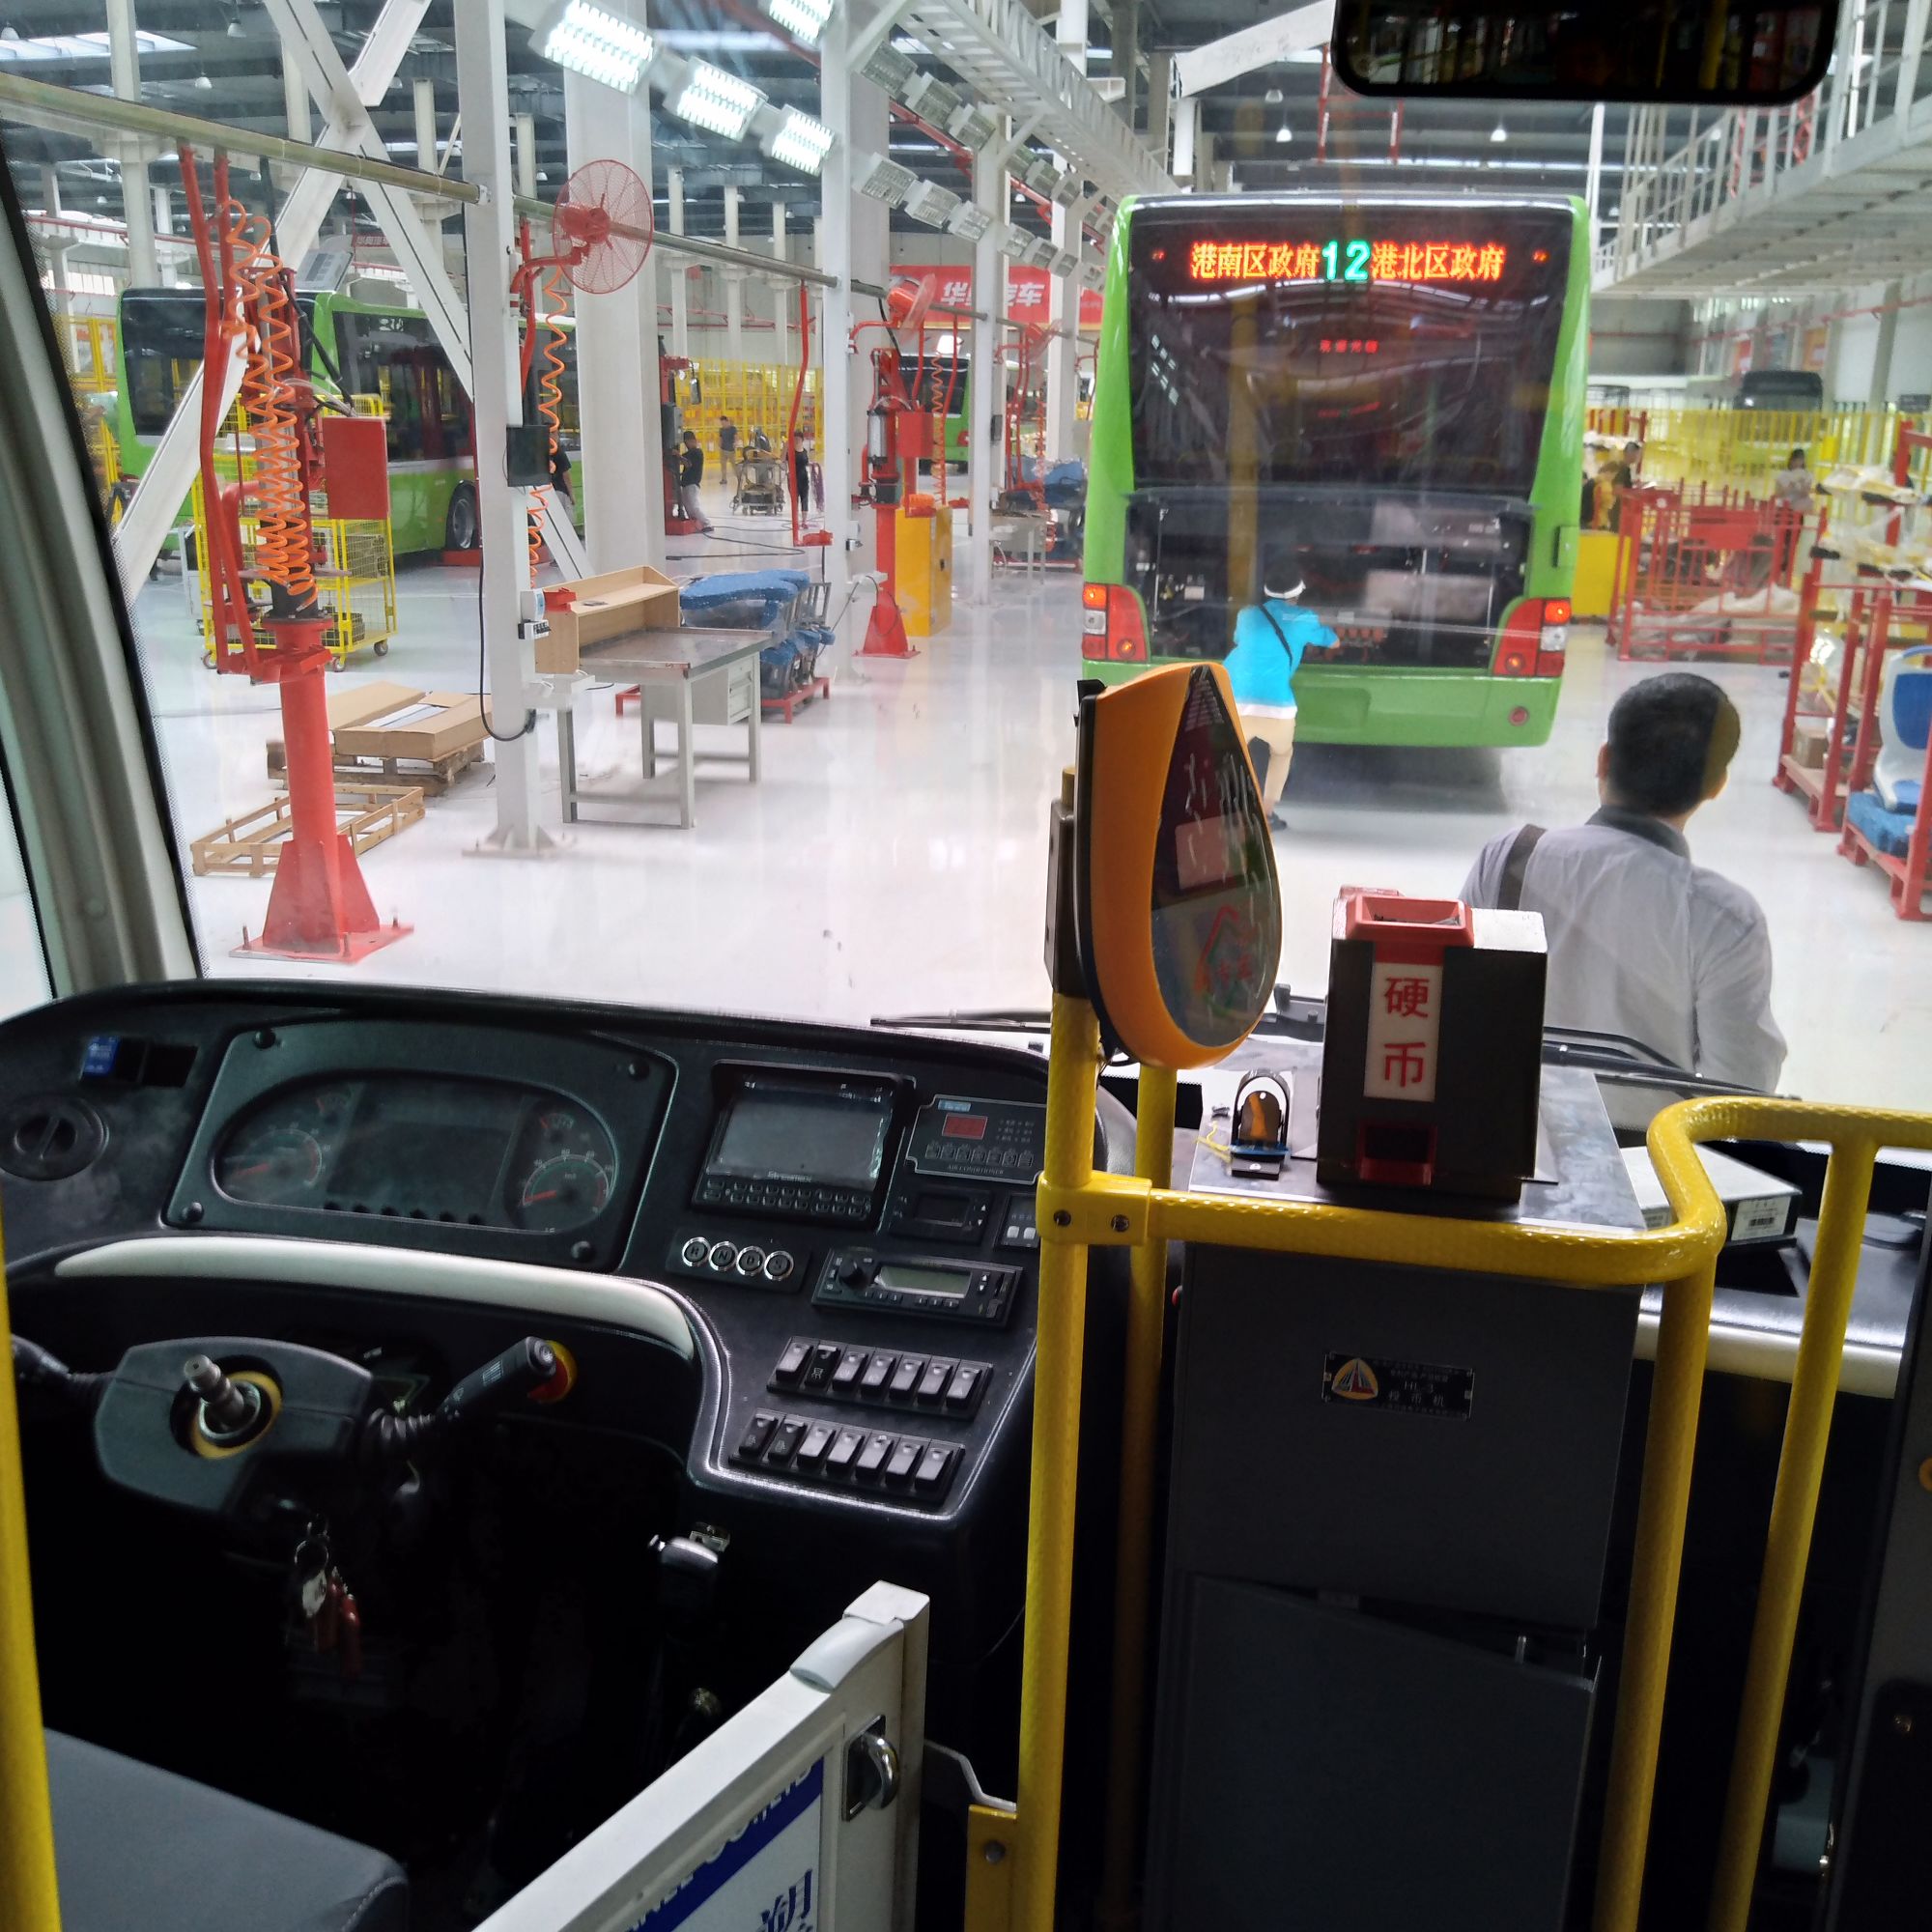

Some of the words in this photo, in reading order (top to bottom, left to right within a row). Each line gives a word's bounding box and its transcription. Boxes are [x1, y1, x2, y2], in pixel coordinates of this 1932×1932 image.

[1191, 242, 1321, 280] 港南区政府
[1321, 240, 1371, 281] 12
[1372, 242, 1505, 280] 港北区政府
[1383, 977, 1430, 1088] 硬币
